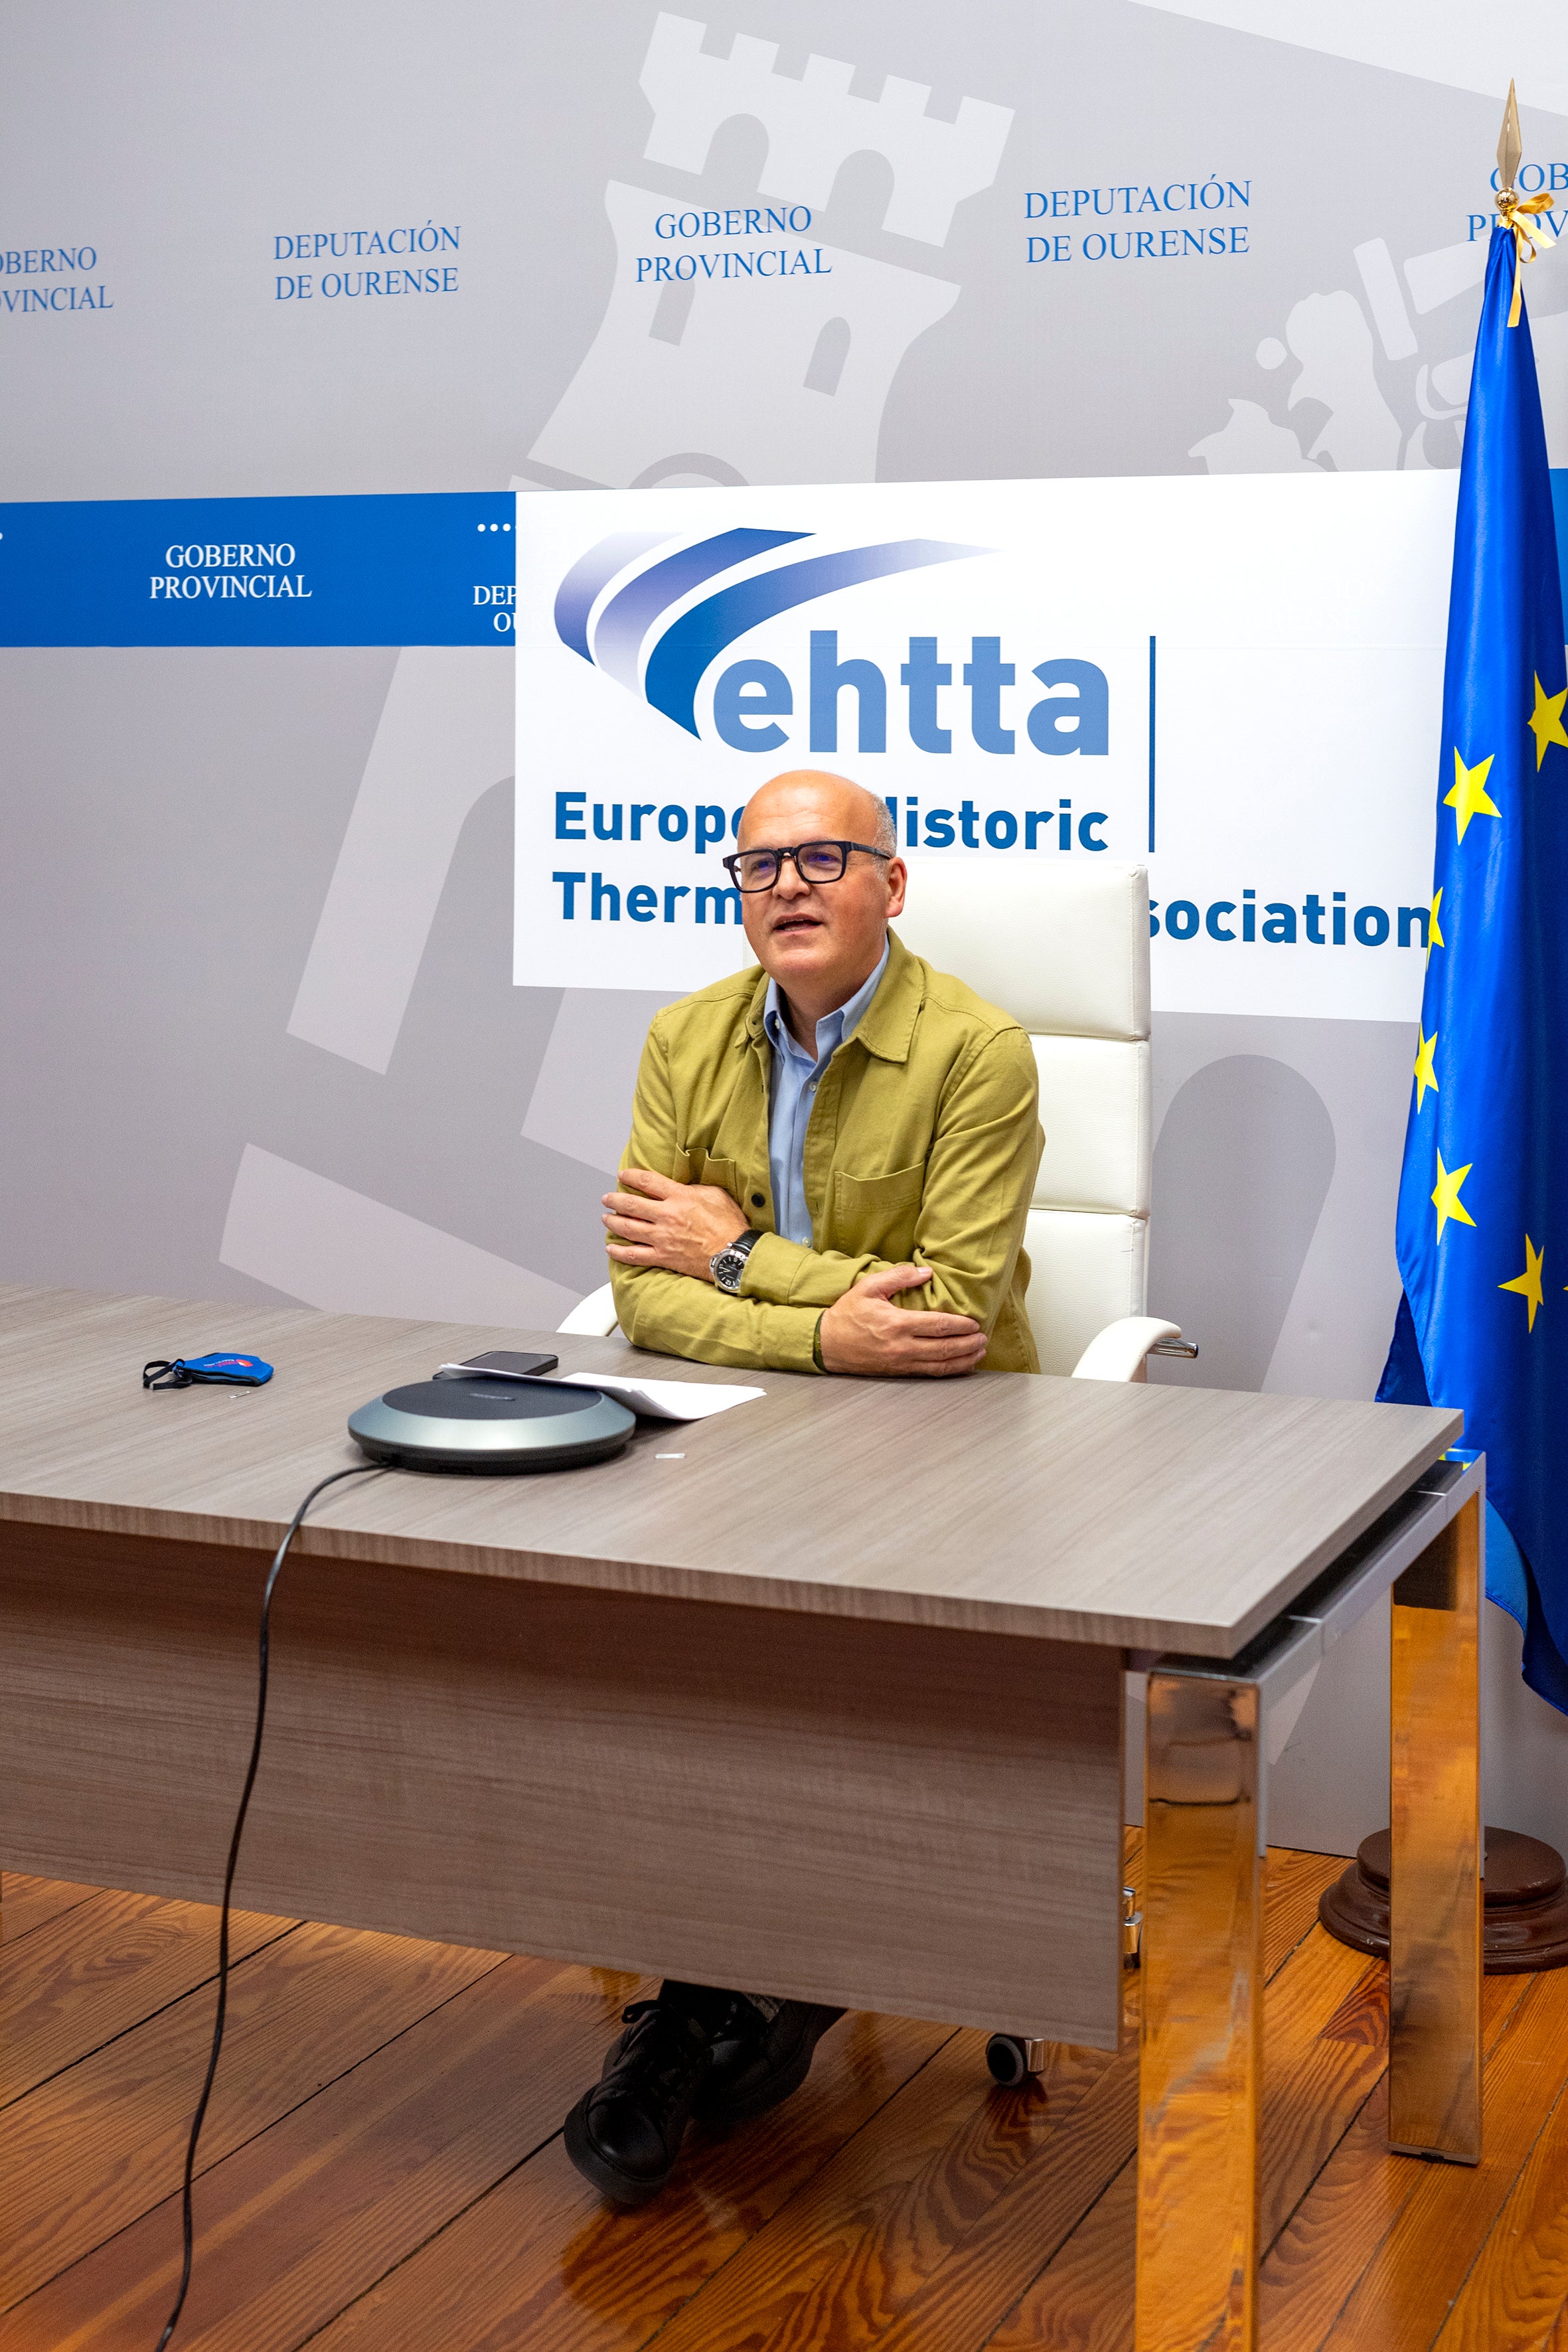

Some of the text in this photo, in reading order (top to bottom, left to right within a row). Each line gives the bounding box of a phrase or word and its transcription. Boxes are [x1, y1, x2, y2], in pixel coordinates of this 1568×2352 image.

[1026, 174, 1252, 220] DEPUTACIÓN
[274, 220, 462, 260] DEPUTACIÓN
[655, 206, 813, 240] GOBERNO
[0, 246, 98, 274] BERNO
[1028, 226, 1251, 265] DE OURENSE
[635, 248, 833, 283] PROVINCIAL
[0, 285, 114, 313] VINCIAL
[275, 267, 460, 301] DE OURENSE
[165, 543, 297, 569] GOBERNO
[149, 574, 313, 599] PROVINCIAL
[712, 629, 1110, 756] ehtta
[555, 791, 745, 854] Europ
[552, 871, 744, 925] Therm
